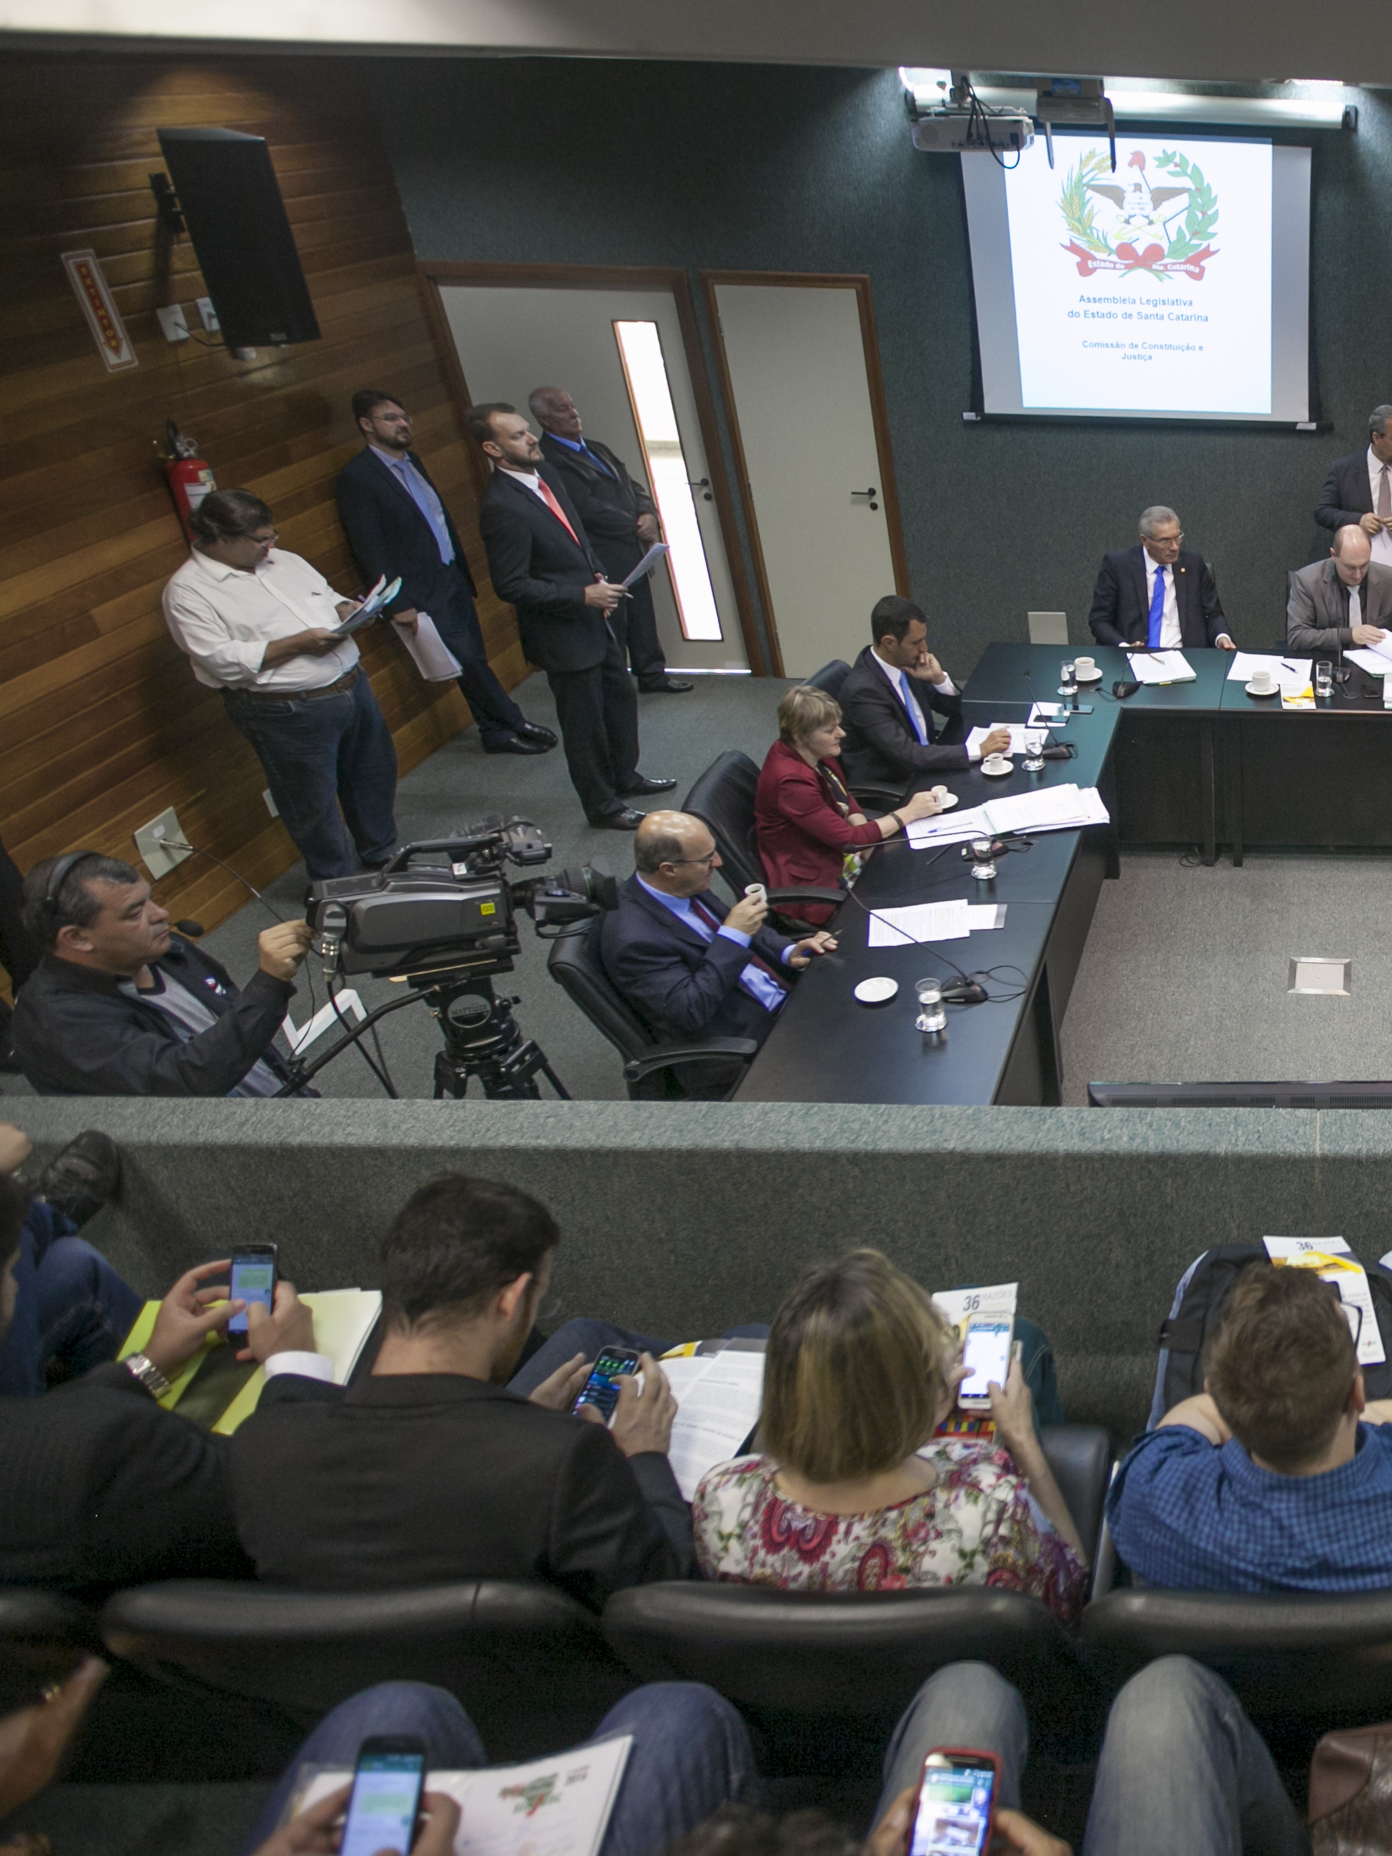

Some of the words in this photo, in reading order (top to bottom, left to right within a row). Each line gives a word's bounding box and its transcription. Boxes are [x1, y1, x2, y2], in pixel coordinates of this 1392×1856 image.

[1087, 259, 1114, 269] Estado
[1167, 263, 1200, 274] Catarina
[1079, 294, 1137, 305] Assembleia
[1139, 296, 1193, 308] Legislativa
[1067, 309, 1080, 319] do
[1083, 309, 1118, 320] Estado
[1121, 310, 1133, 320] de
[1136, 311, 1165, 321] Santa
[1167, 312, 1209, 323] Catarina
[1082, 340, 1126, 350] Comissão
[1128, 341, 1139, 350] de
[1141, 341, 1196, 352] Constituição
[1121, 352, 1153, 362] Justiça
[963, 1294, 980, 1312] 36
